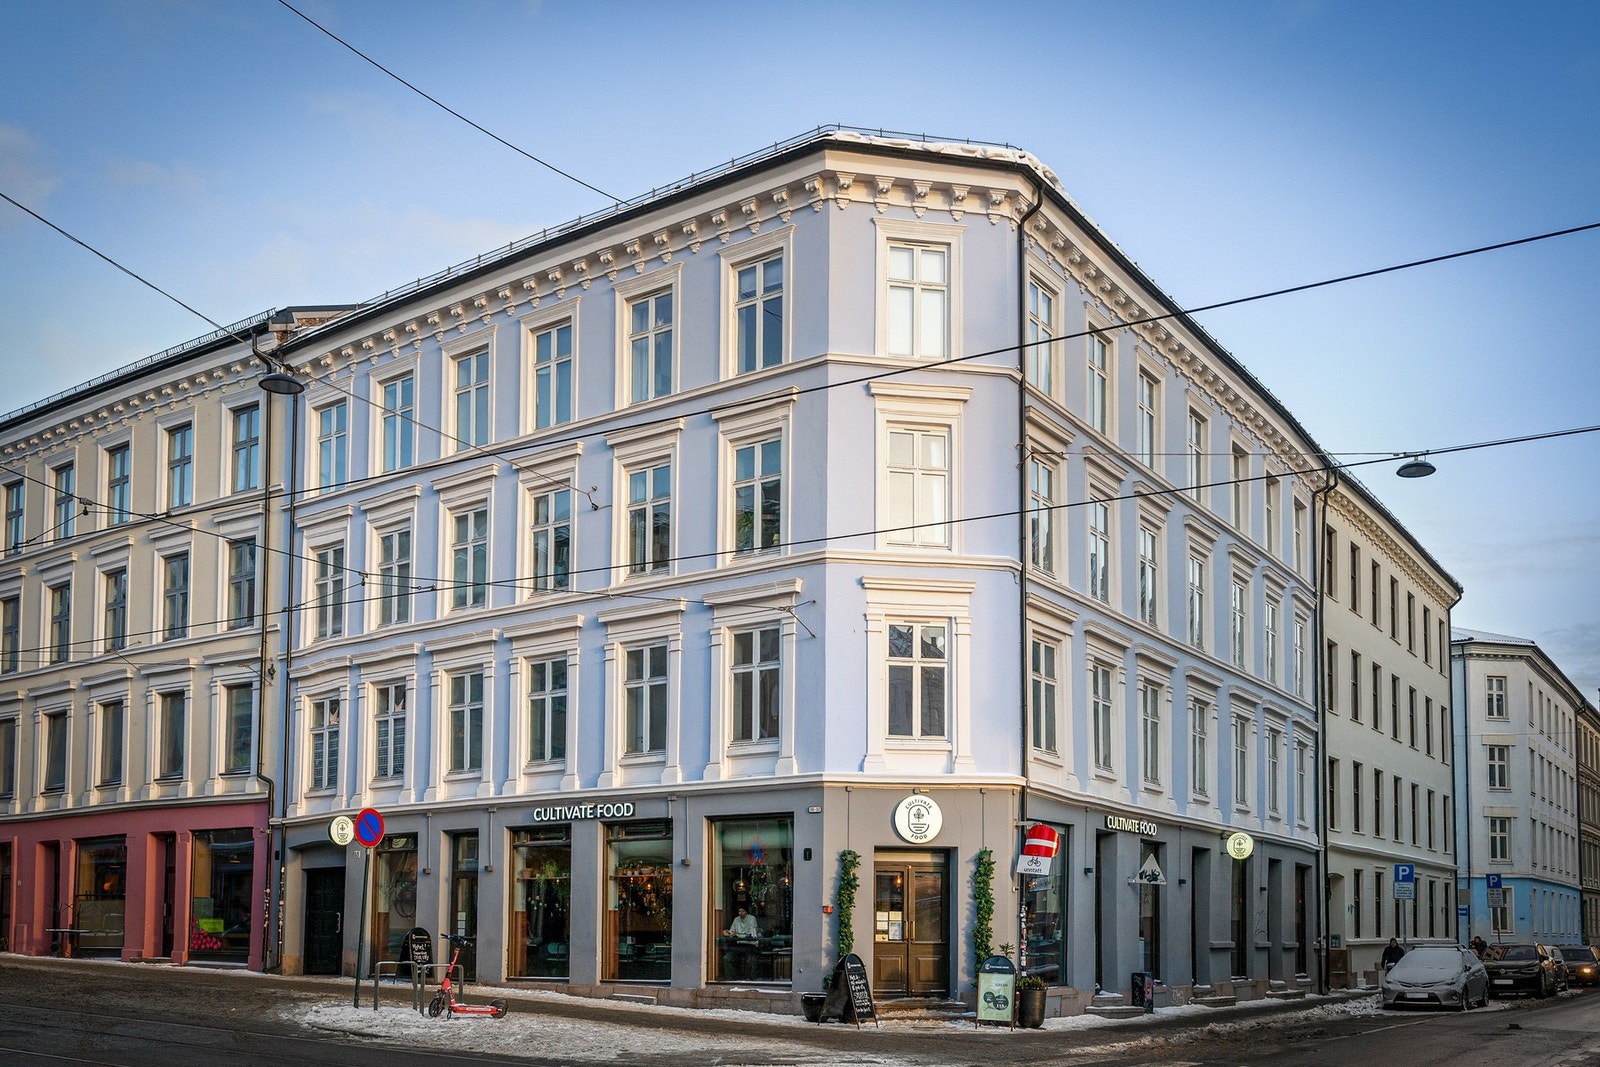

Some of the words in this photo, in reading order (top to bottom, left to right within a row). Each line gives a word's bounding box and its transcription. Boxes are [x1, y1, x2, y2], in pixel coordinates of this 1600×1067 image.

[905, 799, 932, 809] CULTIVATE
[533, 805, 594, 821] CULTIVATE
[597, 802, 633, 817] FOOD
[1107, 815, 1139, 833] CULTIVATE
[1140, 821, 1157, 836] FOOD
[1398, 866, 1410, 880] P
[1490, 875, 1499, 887] P
